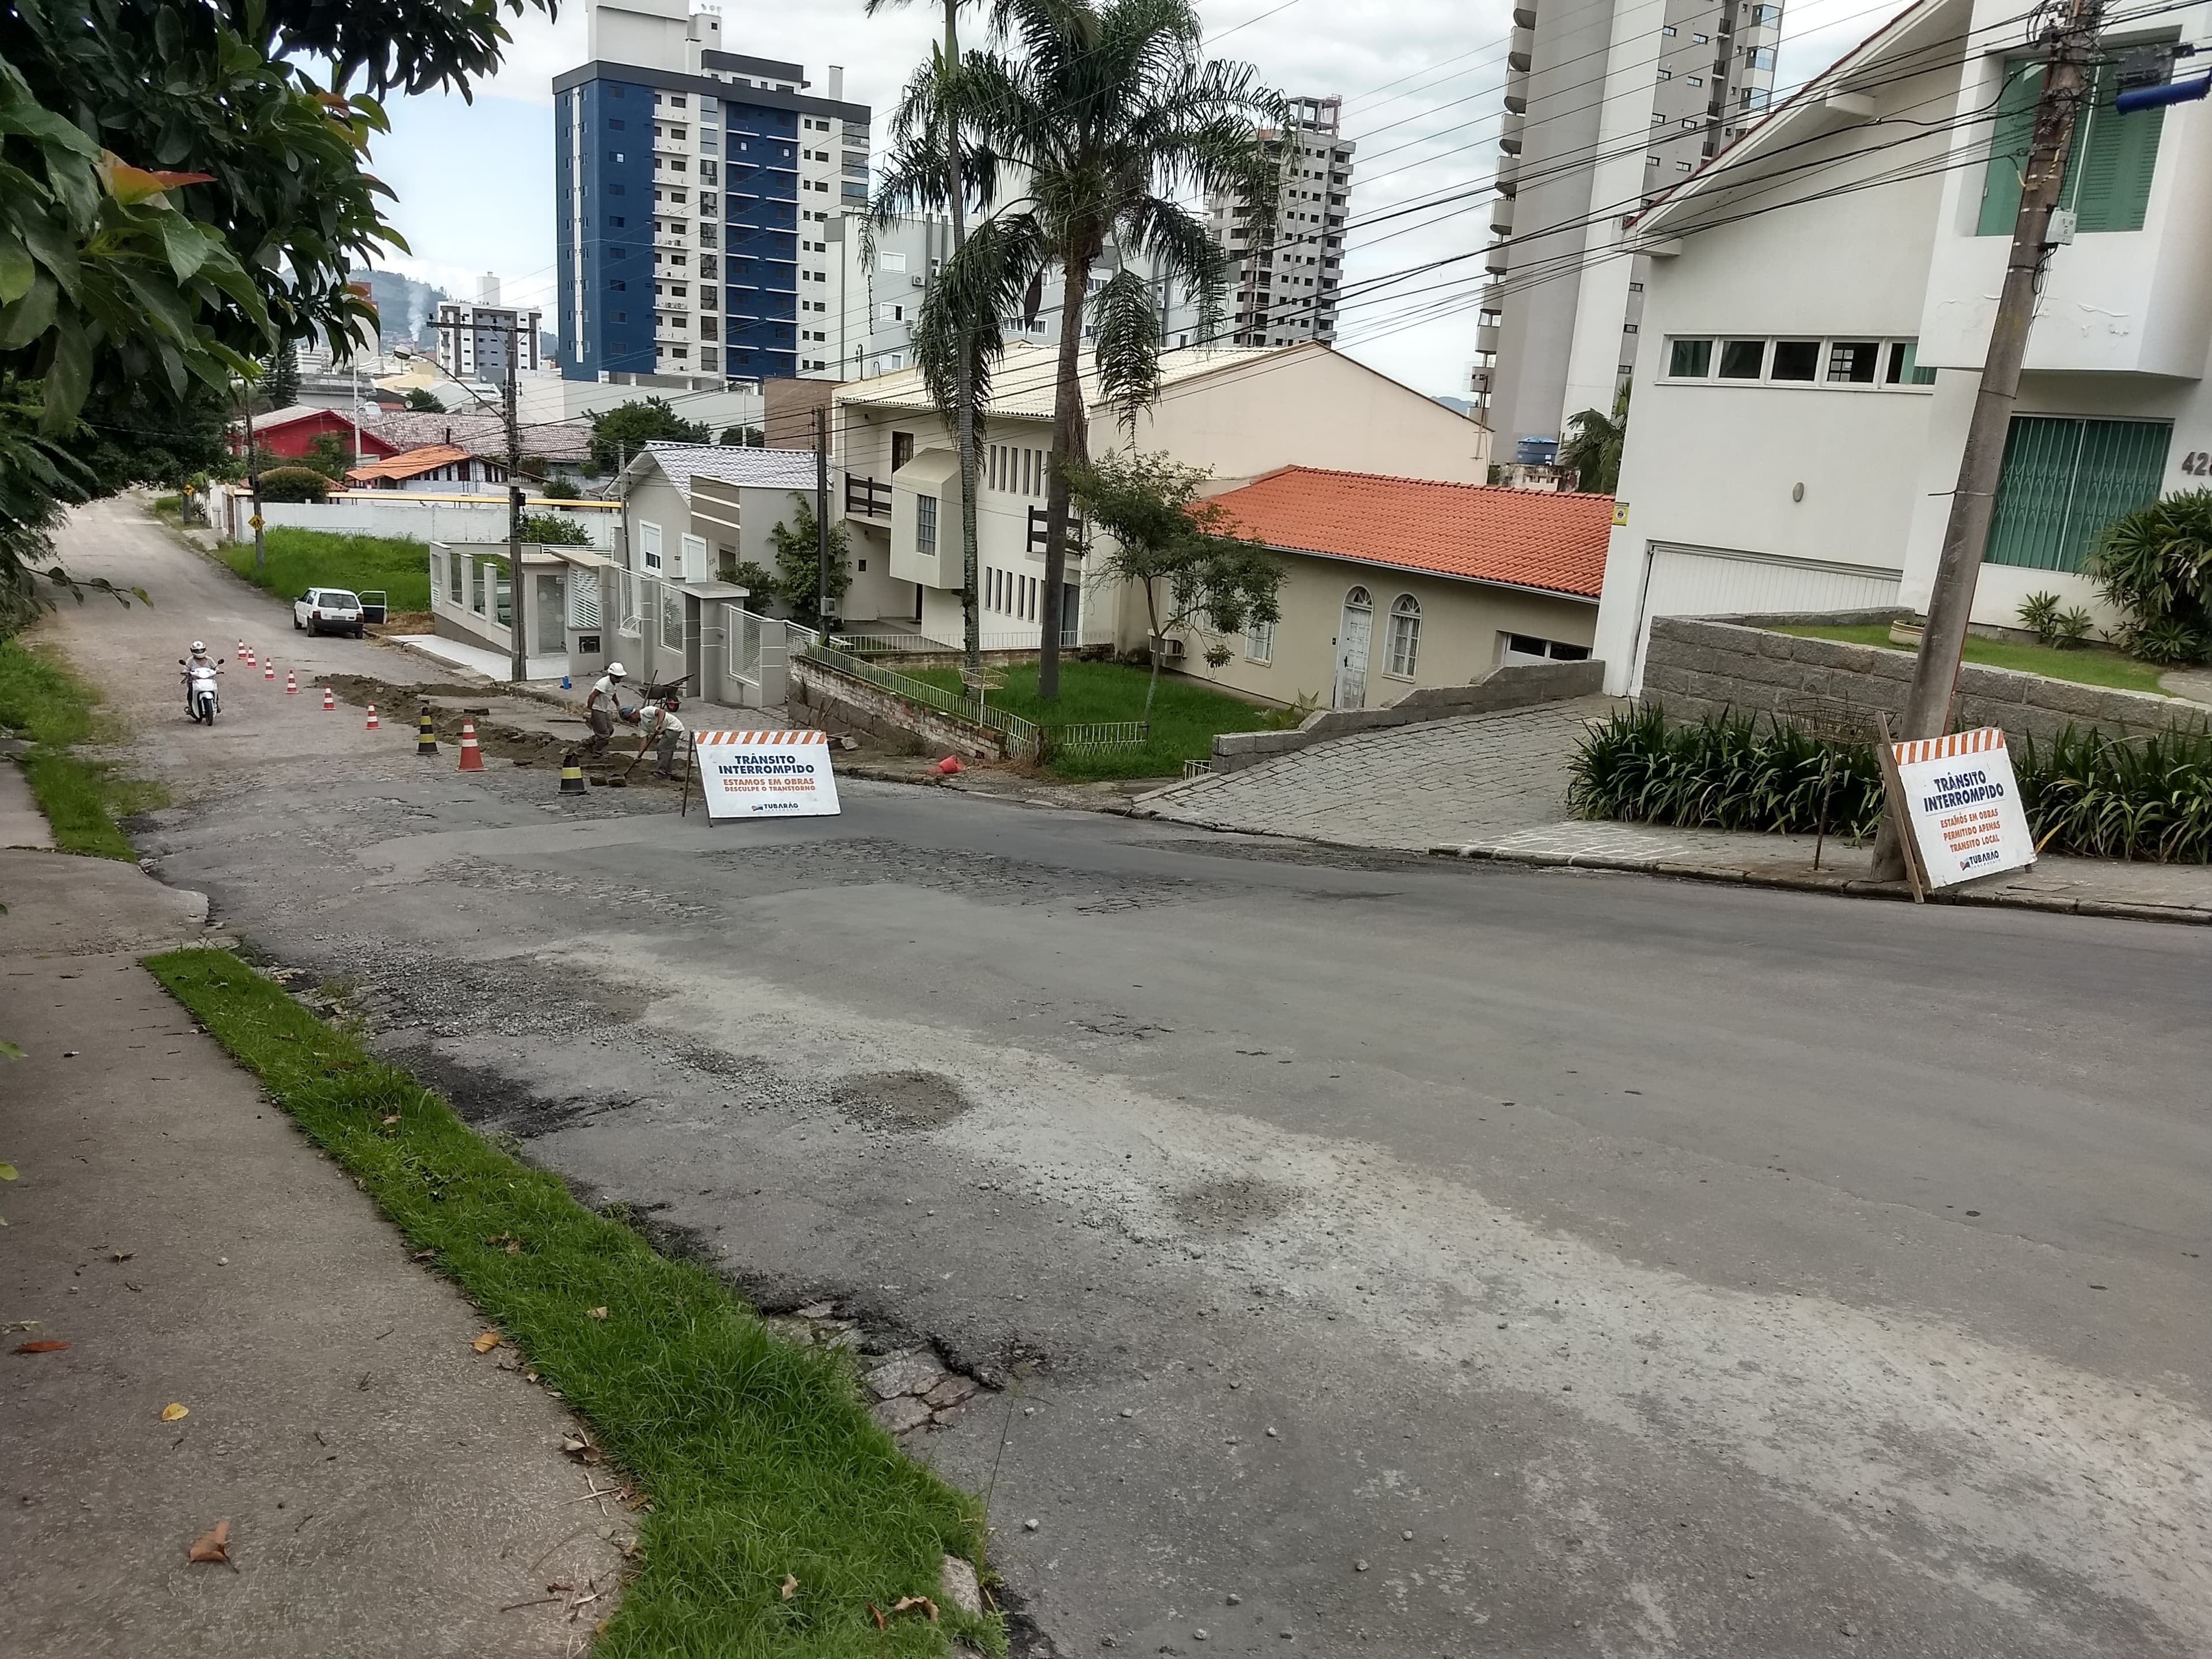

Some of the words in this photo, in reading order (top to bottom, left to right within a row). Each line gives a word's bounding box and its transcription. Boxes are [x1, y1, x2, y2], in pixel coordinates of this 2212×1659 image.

[2181, 451, 2212, 476] 42
[734, 753, 796, 764] TRÂNSITO
[718, 764, 815, 774] INTERROMPIDO
[1933, 770, 1986, 793] TRÂNSITO
[763, 801, 799, 809] TUBARÃO
[1923, 783, 2005, 812] INTERROMPIDO
[1940, 815, 1968, 828] ESTAMOS
[1969, 813, 1979, 822] EM
[1979, 808, 1999, 820] OBRAS
[1943, 826, 1977, 842] PERMITIDO
[1979, 821, 2001, 834] APENAS
[1949, 838, 1980, 853] TRANSITO
[1982, 834, 2000, 845] LOCAL
[1969, 849, 1999, 865] TUBARÃO
